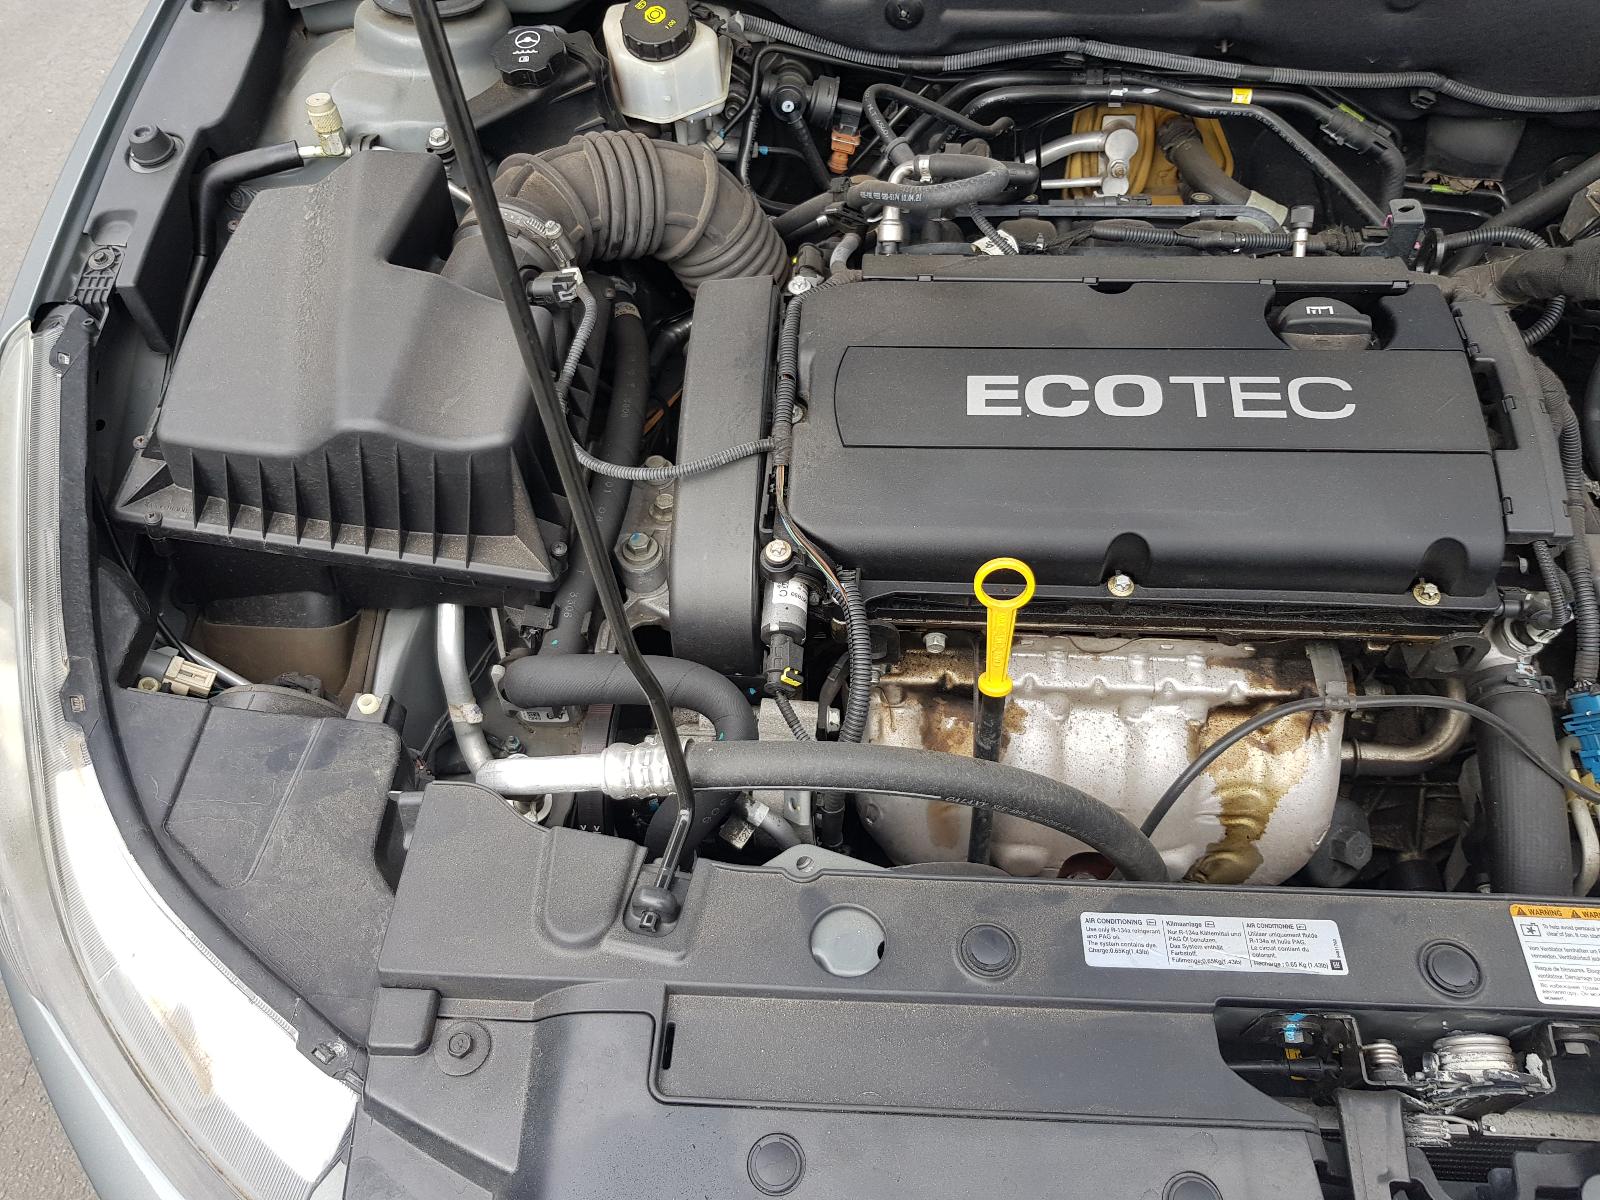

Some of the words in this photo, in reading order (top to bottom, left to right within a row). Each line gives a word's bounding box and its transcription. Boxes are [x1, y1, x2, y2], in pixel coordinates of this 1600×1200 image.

[966, 374, 1356, 420] ECOTEC
[1528, 908, 1562, 917] WARNING
[1582, 911, 1600, 919] WAR
